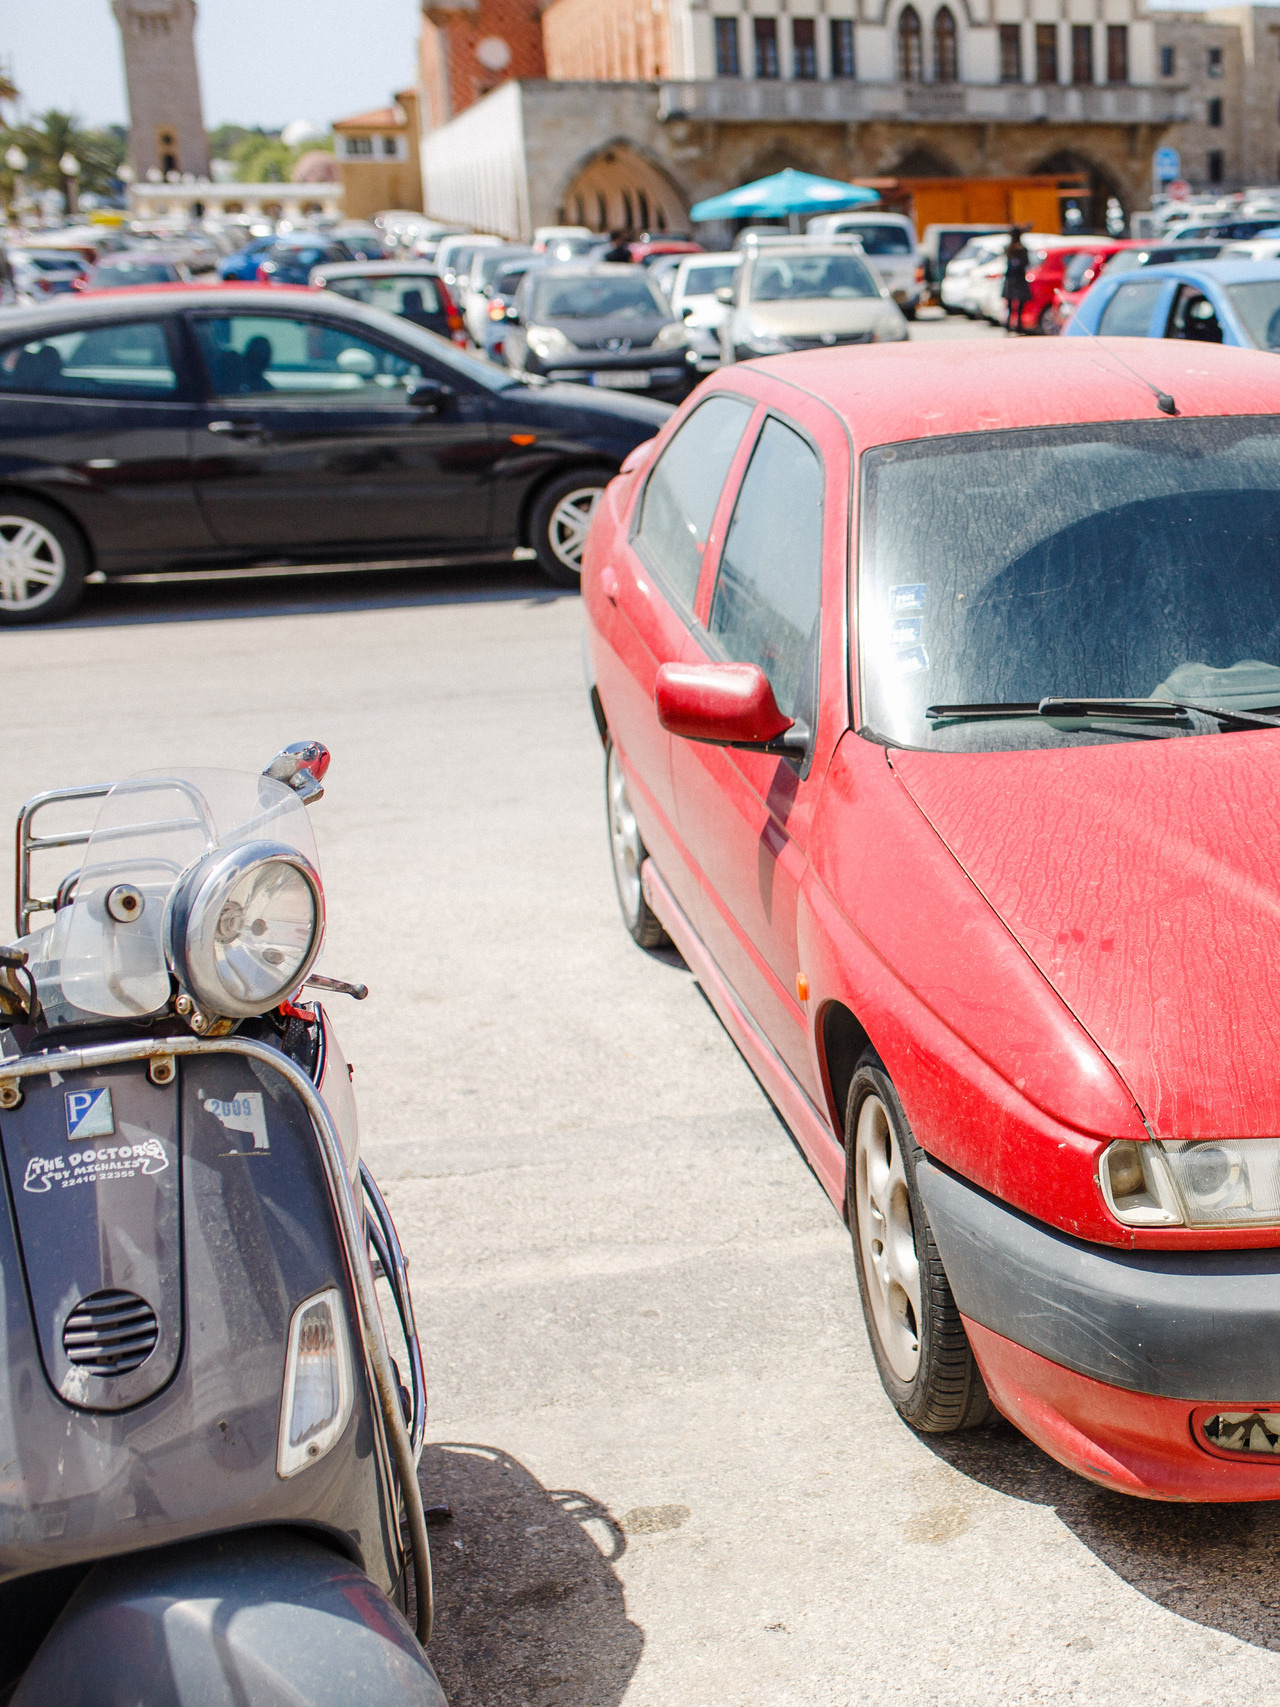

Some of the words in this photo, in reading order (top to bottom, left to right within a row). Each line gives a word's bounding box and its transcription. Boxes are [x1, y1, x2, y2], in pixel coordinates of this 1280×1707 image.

[67, 1093, 92, 1123] P
[211, 1099, 251, 1117] 2009
[32, 1156, 65, 1174] THE
[68, 1143, 161, 1167] DOCTORS
[54, 1170, 71, 1180] BY
[74, 1160, 140, 1176] MICHALIS
[62, 1174, 97, 1188] 22410
[99, 1170, 135, 1180] 22355
